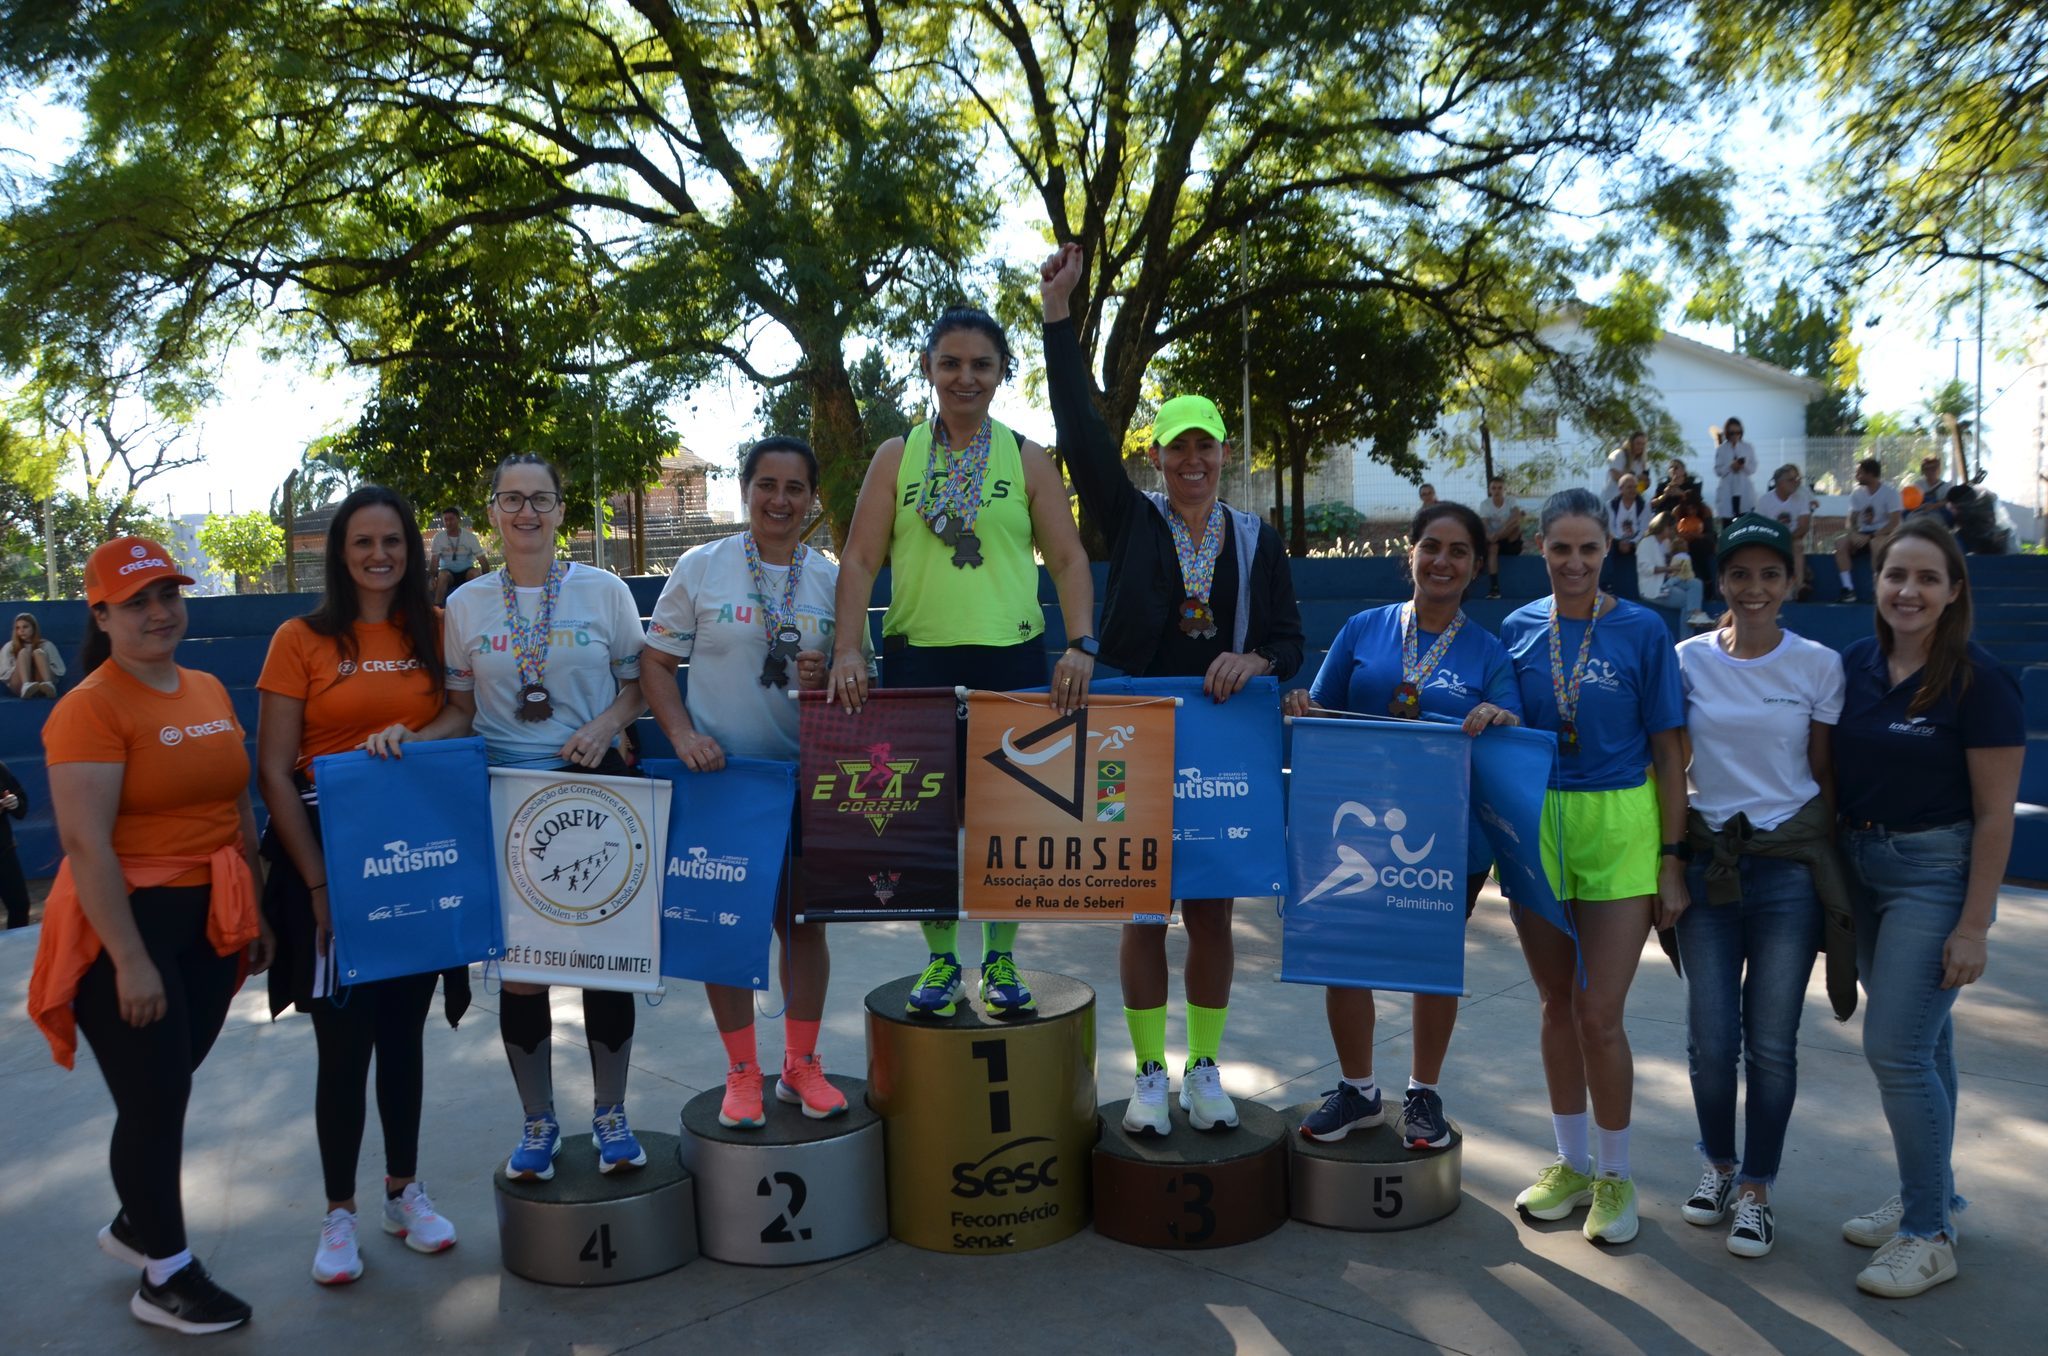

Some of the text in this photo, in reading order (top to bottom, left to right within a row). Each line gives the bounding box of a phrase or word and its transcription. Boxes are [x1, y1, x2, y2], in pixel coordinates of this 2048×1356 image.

[118, 558, 168, 576] CRESOL
[362, 659, 417, 673] CRESO
[184, 719, 235, 738] CRESOL
[812, 772, 945, 800] ELAS
[1173, 779, 1249, 799] utismo
[518, 784, 638, 834] Associação de Corredores de Rua
[837, 800, 920, 813] CORREM
[529, 809, 609, 861] ACORFW
[363, 848, 459, 879] Autismo
[511, 845, 526, 888] Frederico
[986, 835, 1158, 871] ACORSEB
[666, 856, 747, 882] Autismo
[983, 874, 1157, 890] Associação dos Corredores
[1380, 866, 1454, 891] GCOR
[611, 862, 644, 910] Desde 2024
[1015, 895, 1125, 909] de Rua de Seberi
[1386, 895, 1454, 912] Palmitinho
[524, 945, 531, 964] É
[534, 950, 542, 965] O
[544, 951, 567, 967] SEU
[570, 950, 605, 970] ÚNICO
[608, 955, 651, 973] LIMITE!
[972, 1039, 1011, 1134] 1
[757, 1171, 812, 1244] 2
[1166, 1172, 1217, 1243] 3
[1373, 1176, 1403, 1219] 5
[951, 1202, 1060, 1228] Fecomércio
[579, 1223, 617, 1269] 4
[953, 1231, 1014, 1249] Senac
